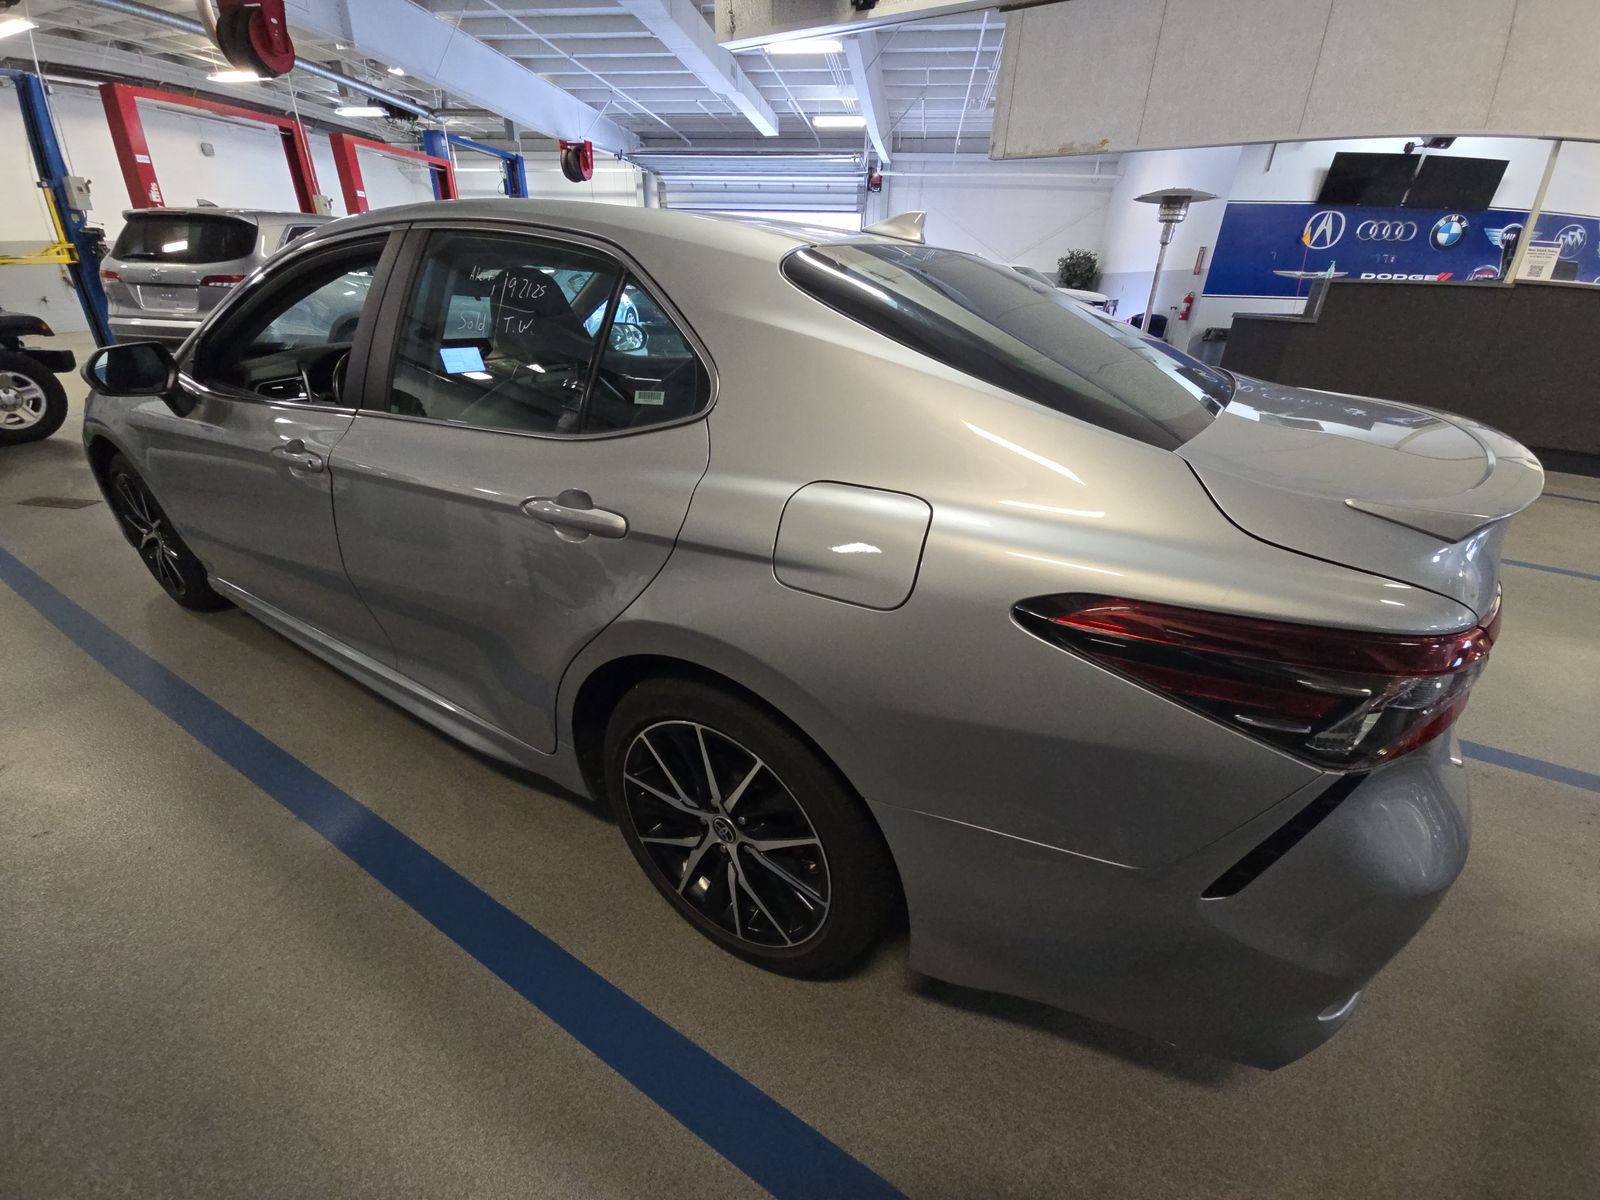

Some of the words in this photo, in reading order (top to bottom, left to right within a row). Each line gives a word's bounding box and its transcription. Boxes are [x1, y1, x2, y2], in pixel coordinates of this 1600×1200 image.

[1438, 215, 1469, 229] BMW
[1360, 272, 1440, 281] DODGE
[457, 311, 486, 331] Sold
